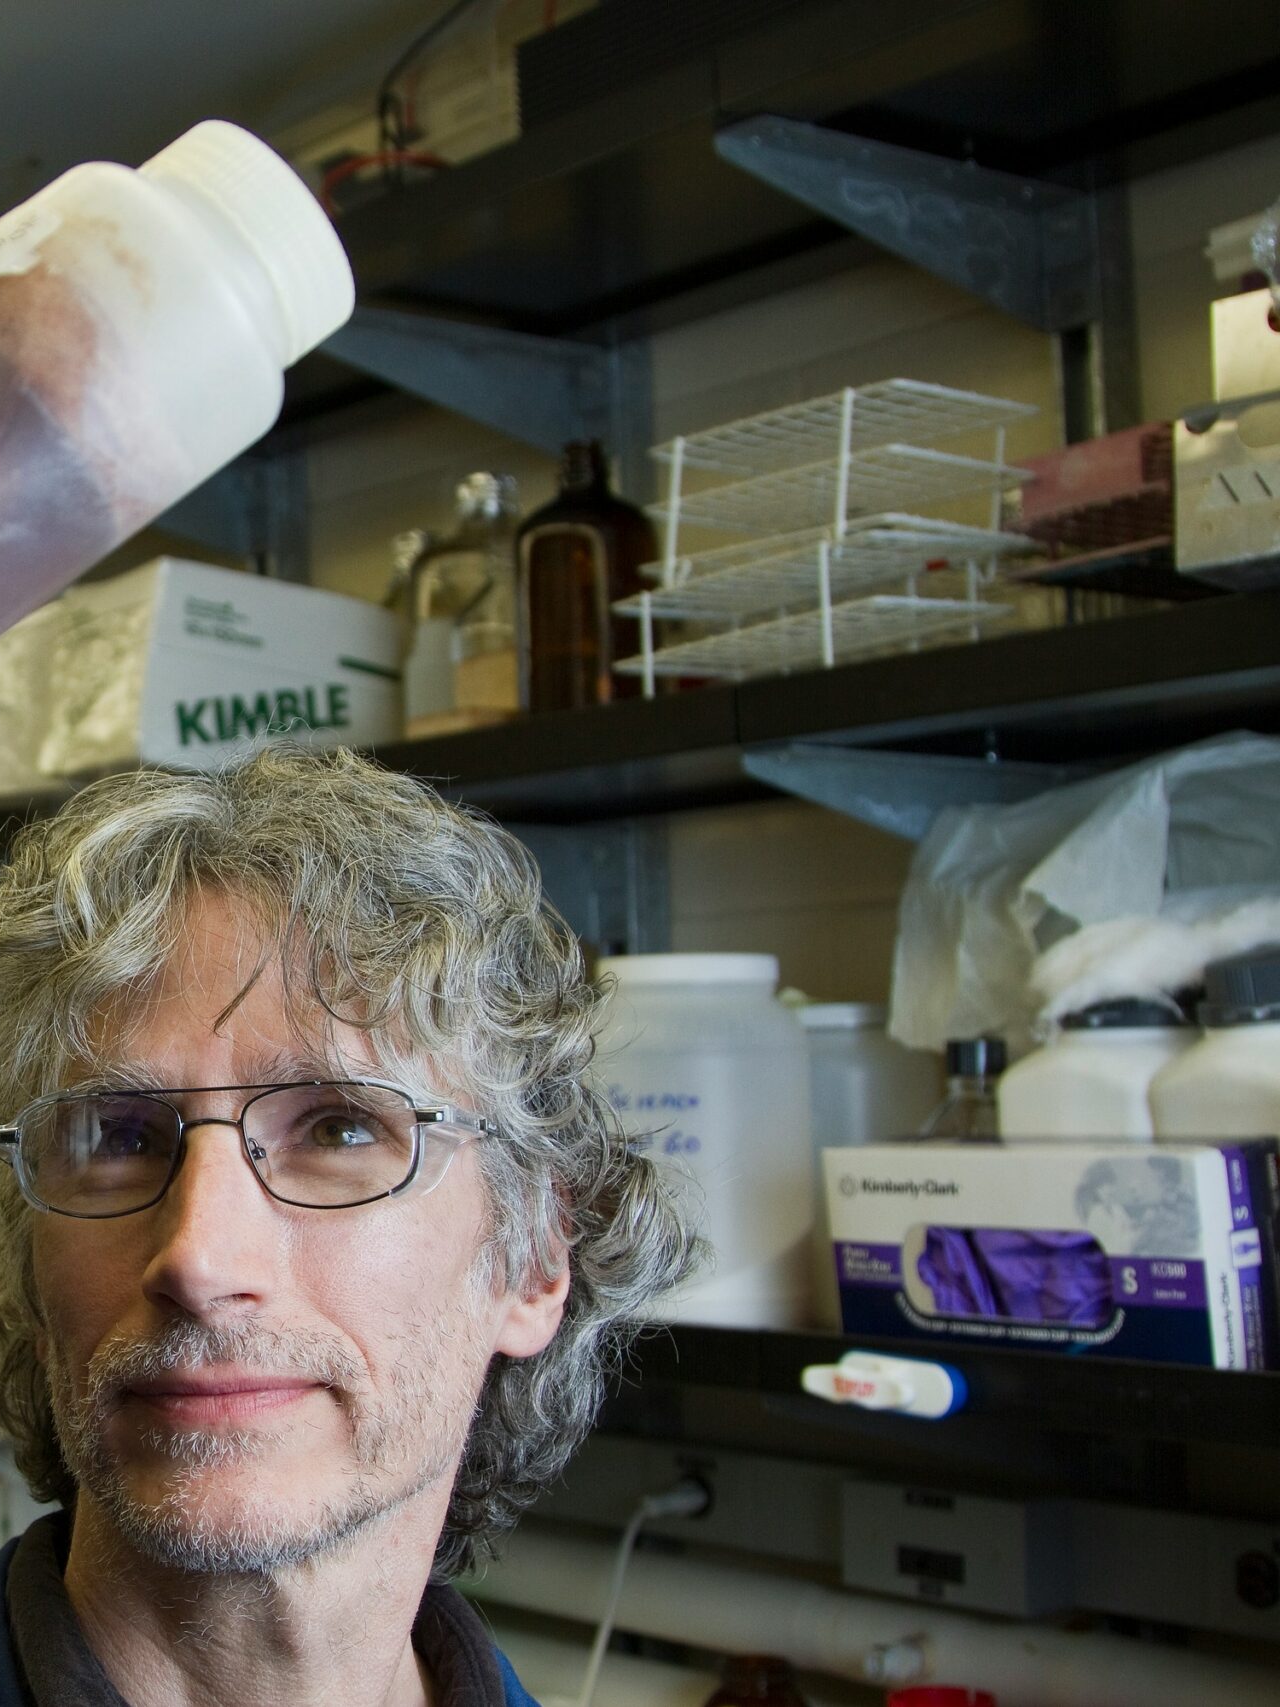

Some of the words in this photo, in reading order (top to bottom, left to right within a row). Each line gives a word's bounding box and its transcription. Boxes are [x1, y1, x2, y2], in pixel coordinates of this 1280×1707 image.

[176, 682, 350, 746] KIMBLE
[1234, 1204, 1249, 1221] S
[1122, 1266, 1138, 1296] S
